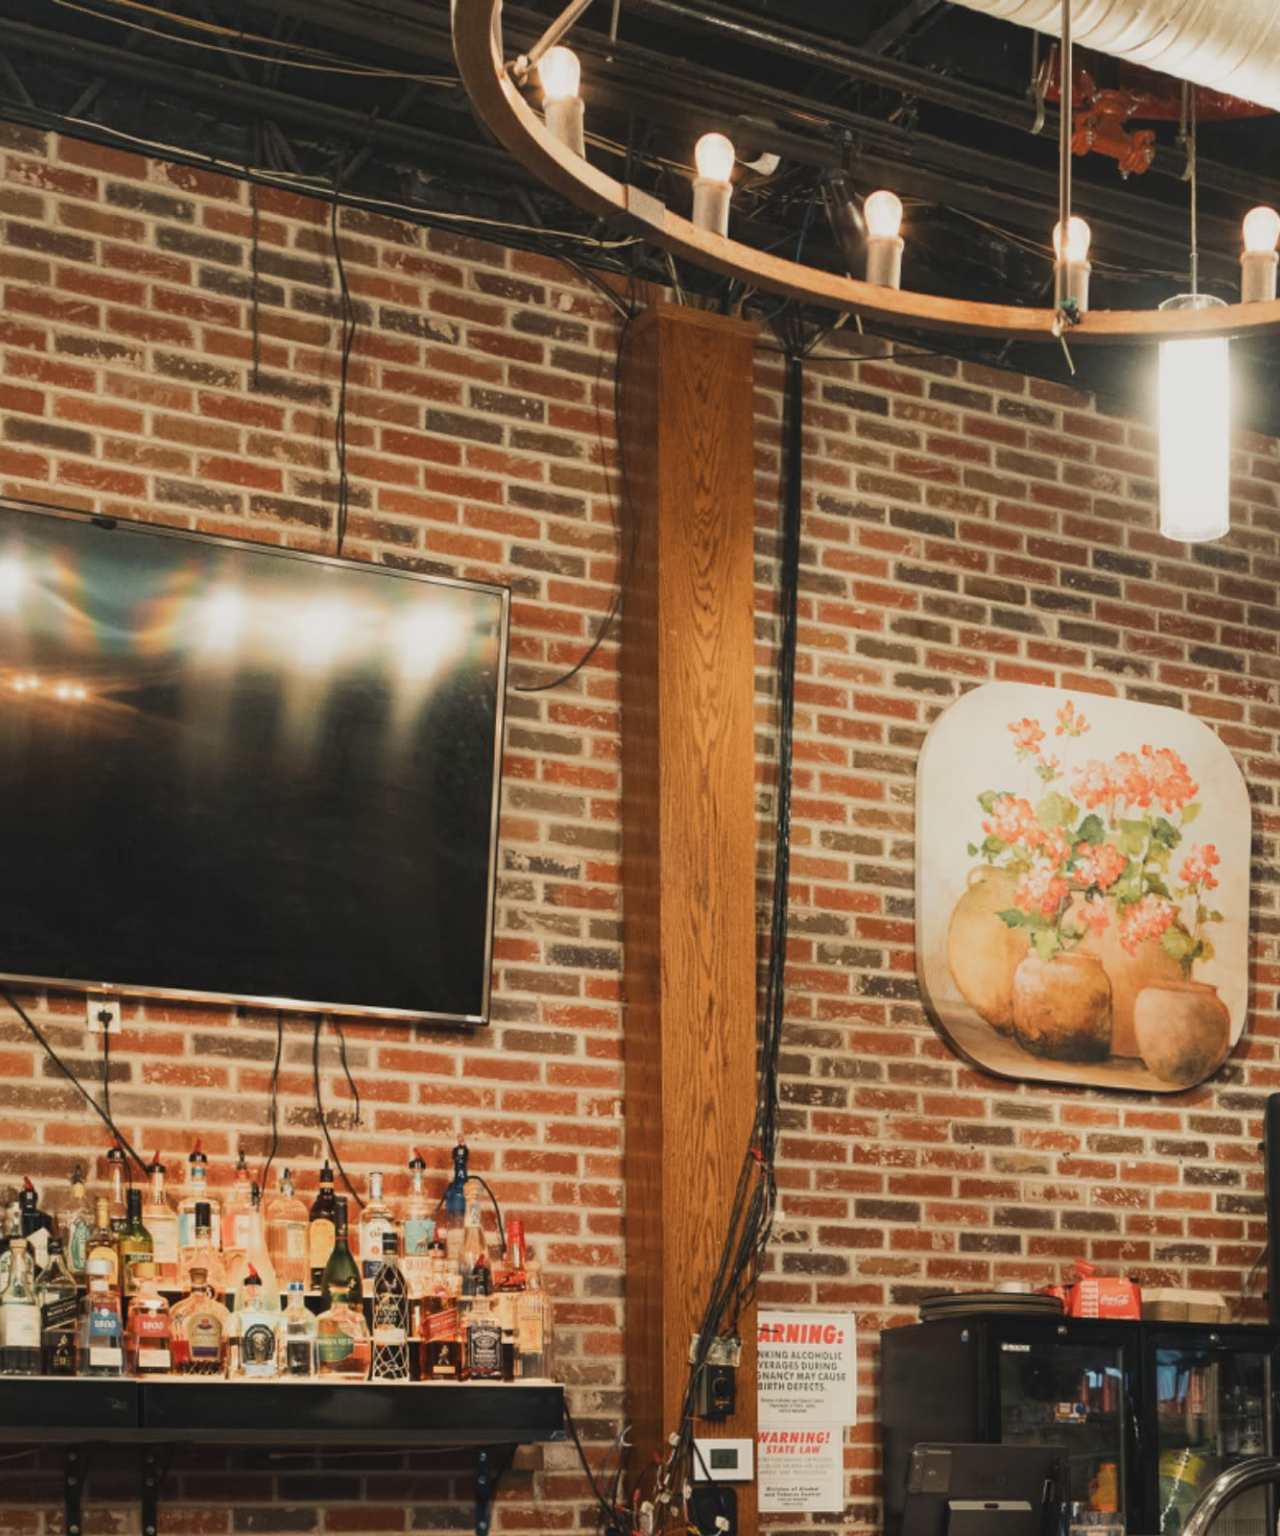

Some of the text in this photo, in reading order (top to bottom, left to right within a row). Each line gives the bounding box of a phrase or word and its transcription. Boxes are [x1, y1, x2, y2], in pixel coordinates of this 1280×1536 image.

[757, 1322, 844, 1344] ARNING:
[791, 1352, 843, 1361] ALCOHOLIC
[758, 1361, 838, 1371] VERAGES DURING
[796, 1372, 817, 1381] MAY
[818, 1372, 846, 1382] CAUSE
[757, 1431, 830, 1444] WARNING!
[766, 1445, 821, 1454] STATE LAW
